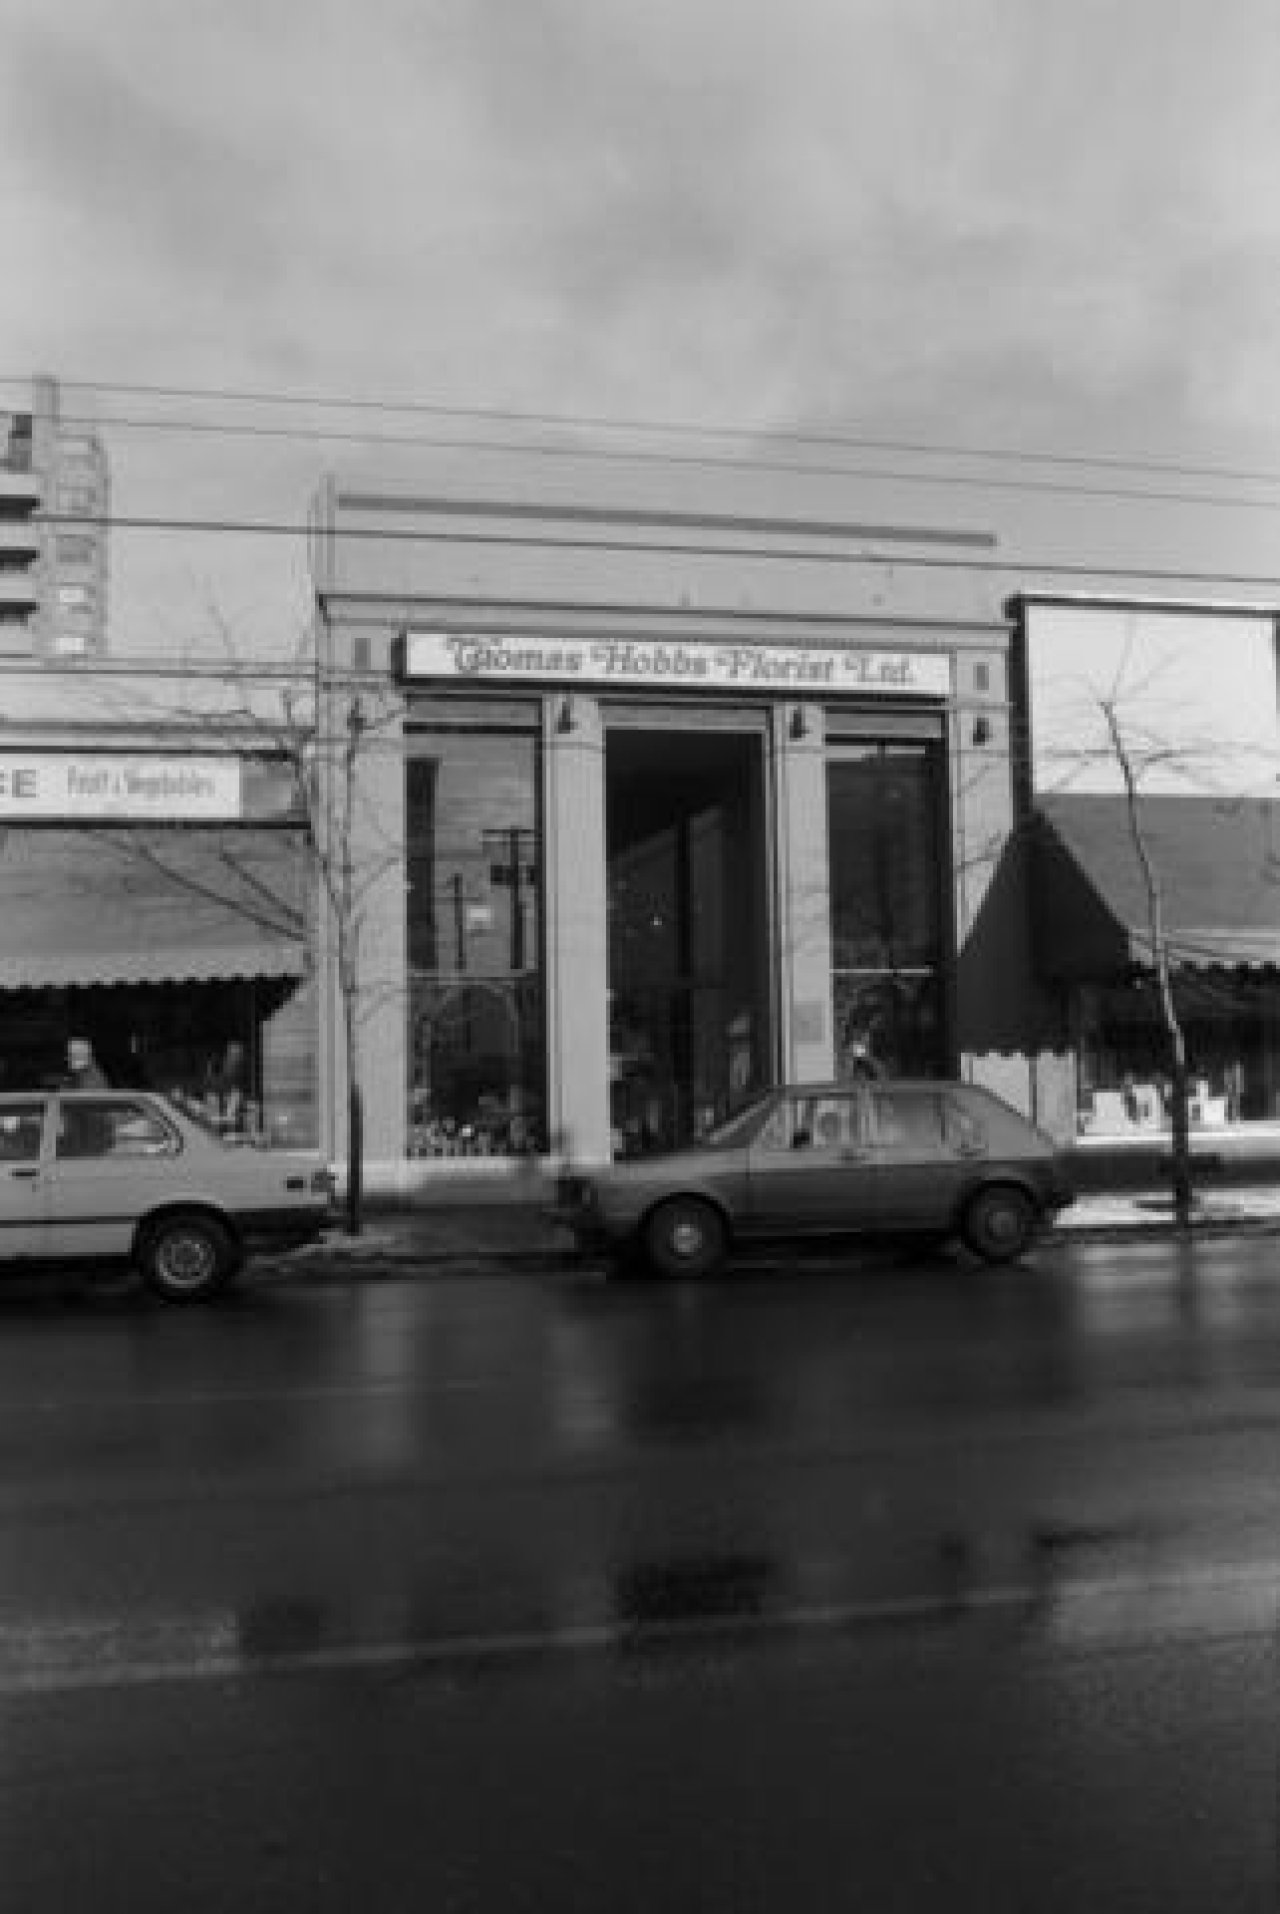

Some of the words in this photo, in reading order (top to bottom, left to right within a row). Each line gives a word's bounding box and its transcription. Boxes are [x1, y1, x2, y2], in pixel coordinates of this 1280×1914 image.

[446, 636, 583, 676] Thomas
[589, 644, 708, 677] Hobbs
[715, 649, 835, 682] Florist
